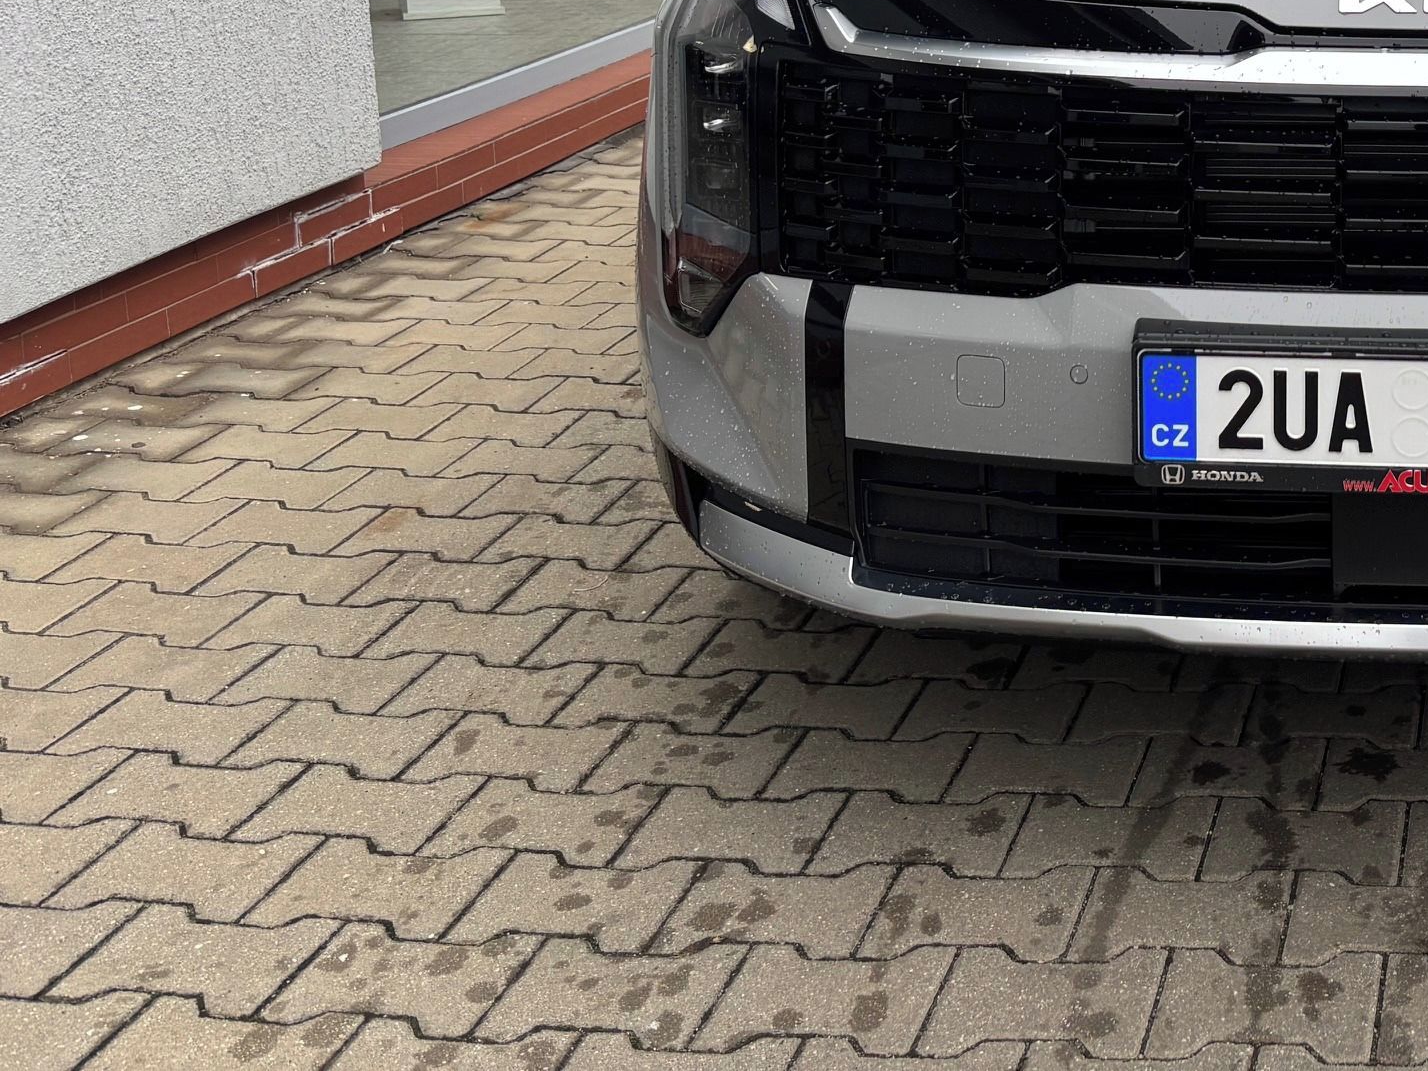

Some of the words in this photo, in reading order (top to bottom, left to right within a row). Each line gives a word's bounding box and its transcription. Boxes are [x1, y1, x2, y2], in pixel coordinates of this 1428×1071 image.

[1218, 369, 1373, 453] 2UA
[1151, 423, 1189, 447] CZ
[1191, 470, 1264, 482] HONDA
